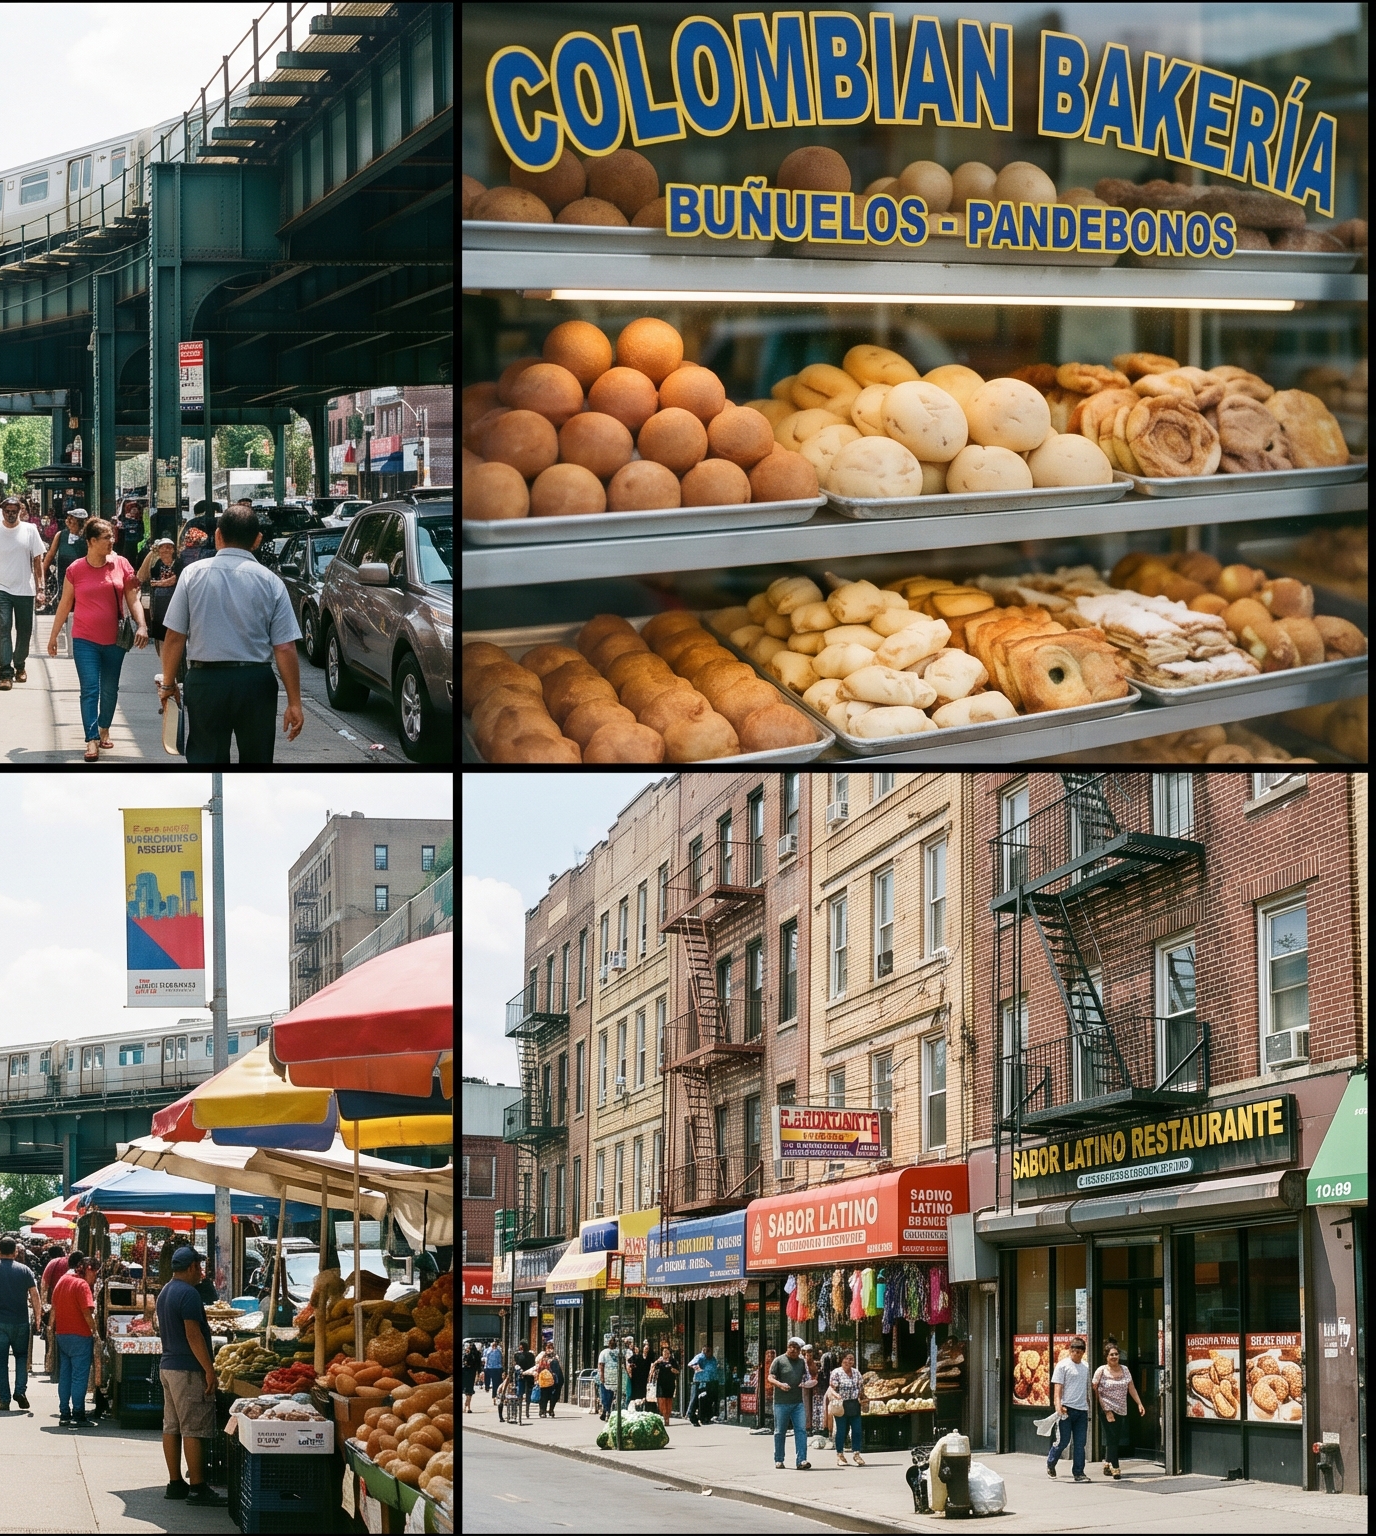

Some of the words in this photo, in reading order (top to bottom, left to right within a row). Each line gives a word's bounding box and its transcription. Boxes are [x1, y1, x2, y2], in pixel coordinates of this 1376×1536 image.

[486, 10, 1013, 173] COLOMBIAN
[1038, 29, 1337, 218] BAKERÍA
[666, 176, 928, 247] BUÑUELOS
[966, 198, 1238, 259] PANDEBONOS
[1013, 1144, 1060, 1180] SABOR
[1064, 1130, 1126, 1171] LATINO
[1131, 1098, 1284, 1159] RESTAURANTE
[768, 1207, 815, 1238] SABOR
[819, 1196, 879, 1232] LATINO
[910, 1202, 954, 1215] LATINO
